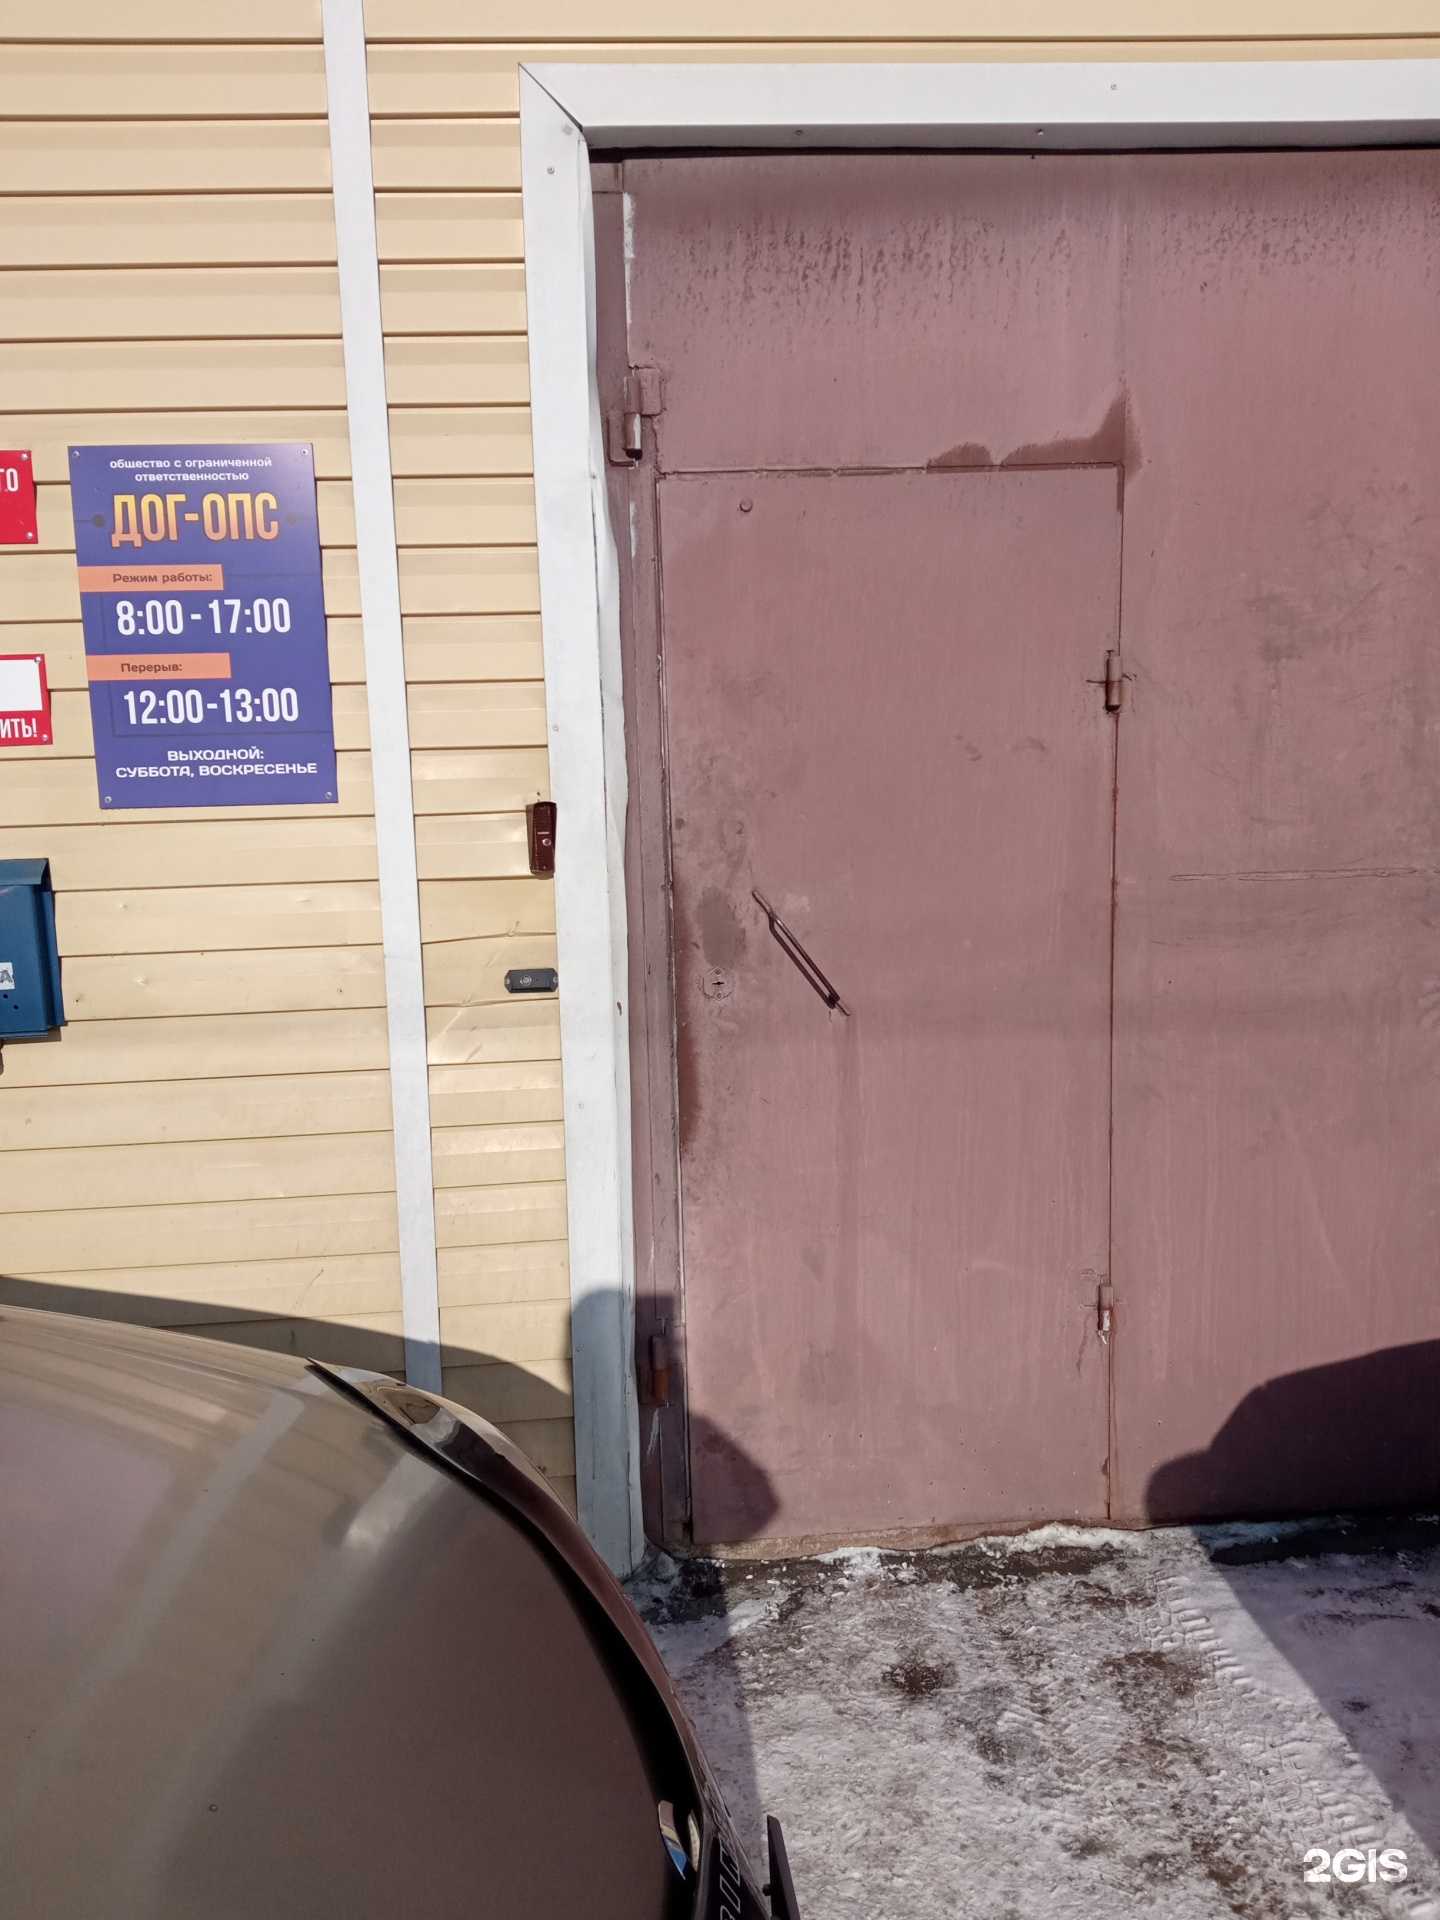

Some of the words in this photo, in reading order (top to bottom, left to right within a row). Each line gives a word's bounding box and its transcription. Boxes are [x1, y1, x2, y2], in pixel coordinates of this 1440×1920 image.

[110, 459, 171, 469] общество
[185, 457, 272, 469] ограниченной
[135, 472, 249, 482] ответственностью
[111, 491, 280, 548] ДОГ-ОПС
[113, 573, 158, 583] Режим
[162, 572, 213, 583] работы:
[116, 599, 183, 636] 8:00
[208, 598, 291, 634] 17:00
[120, 662, 182, 674] Перерыв:
[167, 746, 264, 761] ВЫХОДНОЙ:
[116, 765, 194, 778] СУББОТА,
[199, 763, 318, 776] ВОСКРЕСЕНЬЕ
